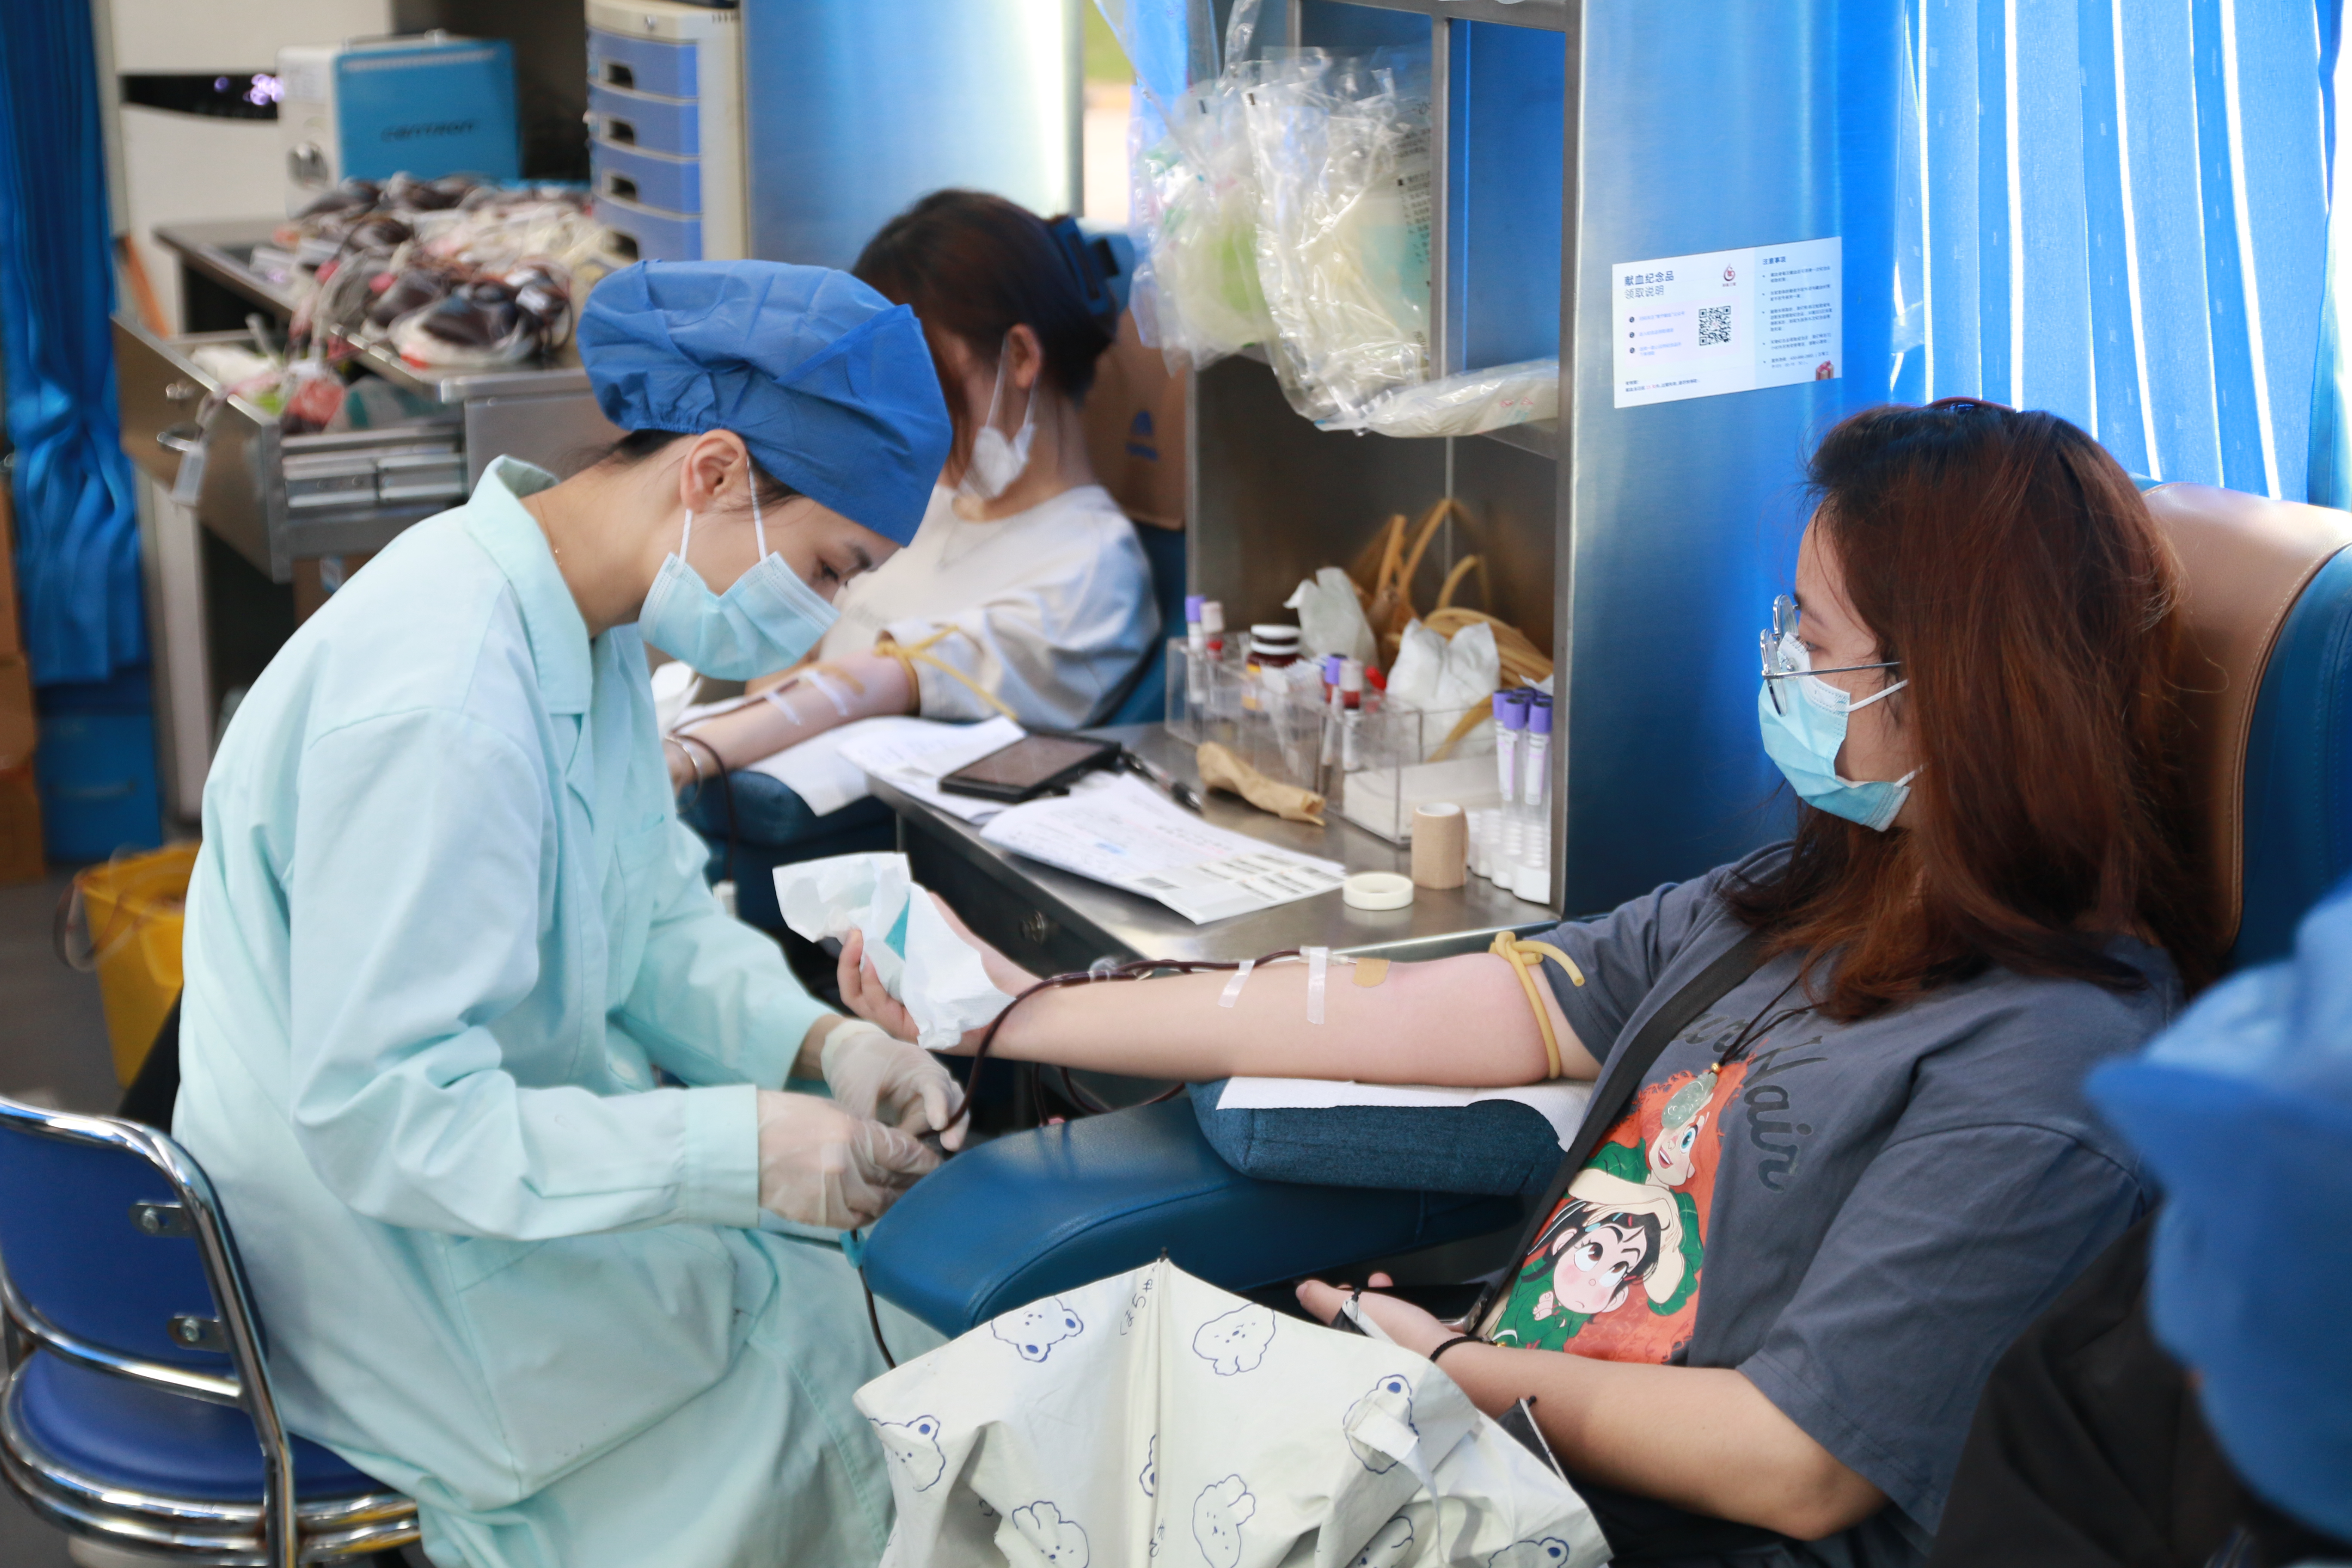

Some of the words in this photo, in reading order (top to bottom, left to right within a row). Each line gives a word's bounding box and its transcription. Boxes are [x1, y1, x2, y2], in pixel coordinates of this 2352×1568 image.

[1624, 270, 1674, 287] 献血纪念品
[1625, 285, 1664, 299] 领取说明
